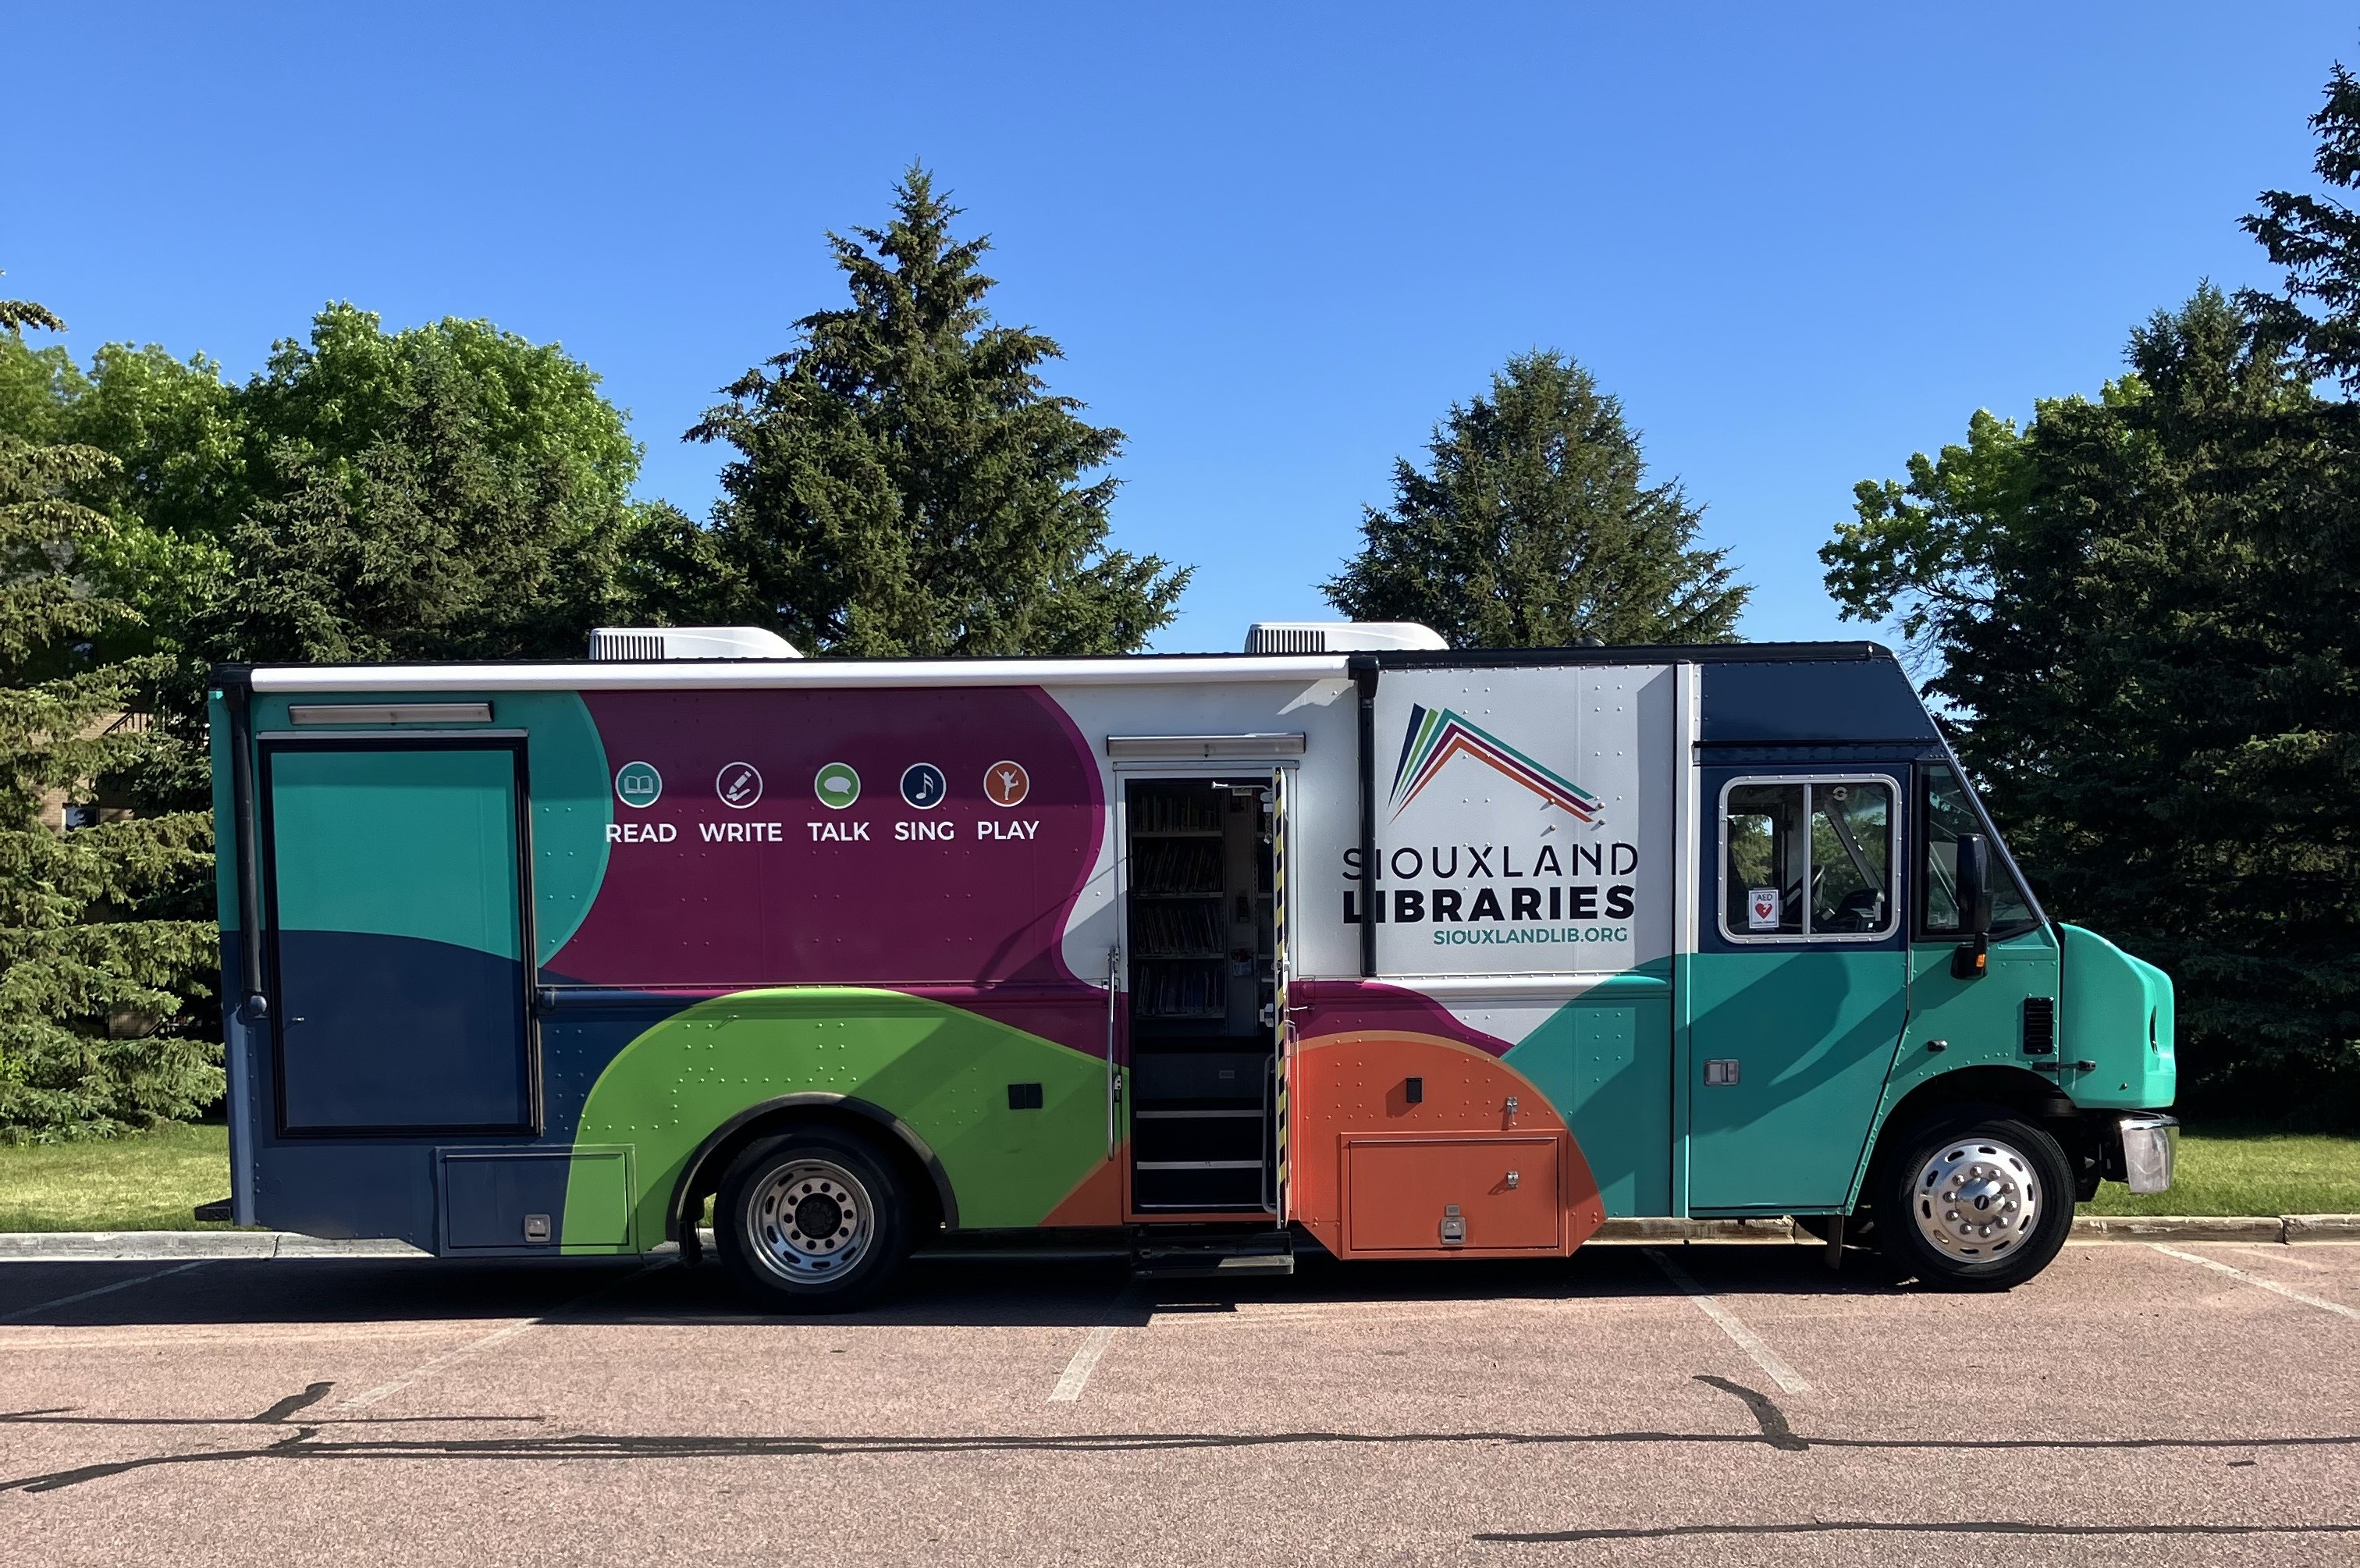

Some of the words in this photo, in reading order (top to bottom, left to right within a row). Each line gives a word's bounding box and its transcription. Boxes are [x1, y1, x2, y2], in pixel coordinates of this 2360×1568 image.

[605, 823, 677, 843] READ
[698, 823, 783, 842] WRITE
[807, 822, 870, 841] TALK
[894, 821, 954, 841] SING
[977, 820, 1040, 840] PLAY
[1342, 843, 1638, 880] SIOUXLAND
[1342, 884, 1635, 924] LIBRARIES
[1756, 893, 1773, 901] AED
[1433, 926, 1628, 945] SIOUXLANDLIB.ORG
